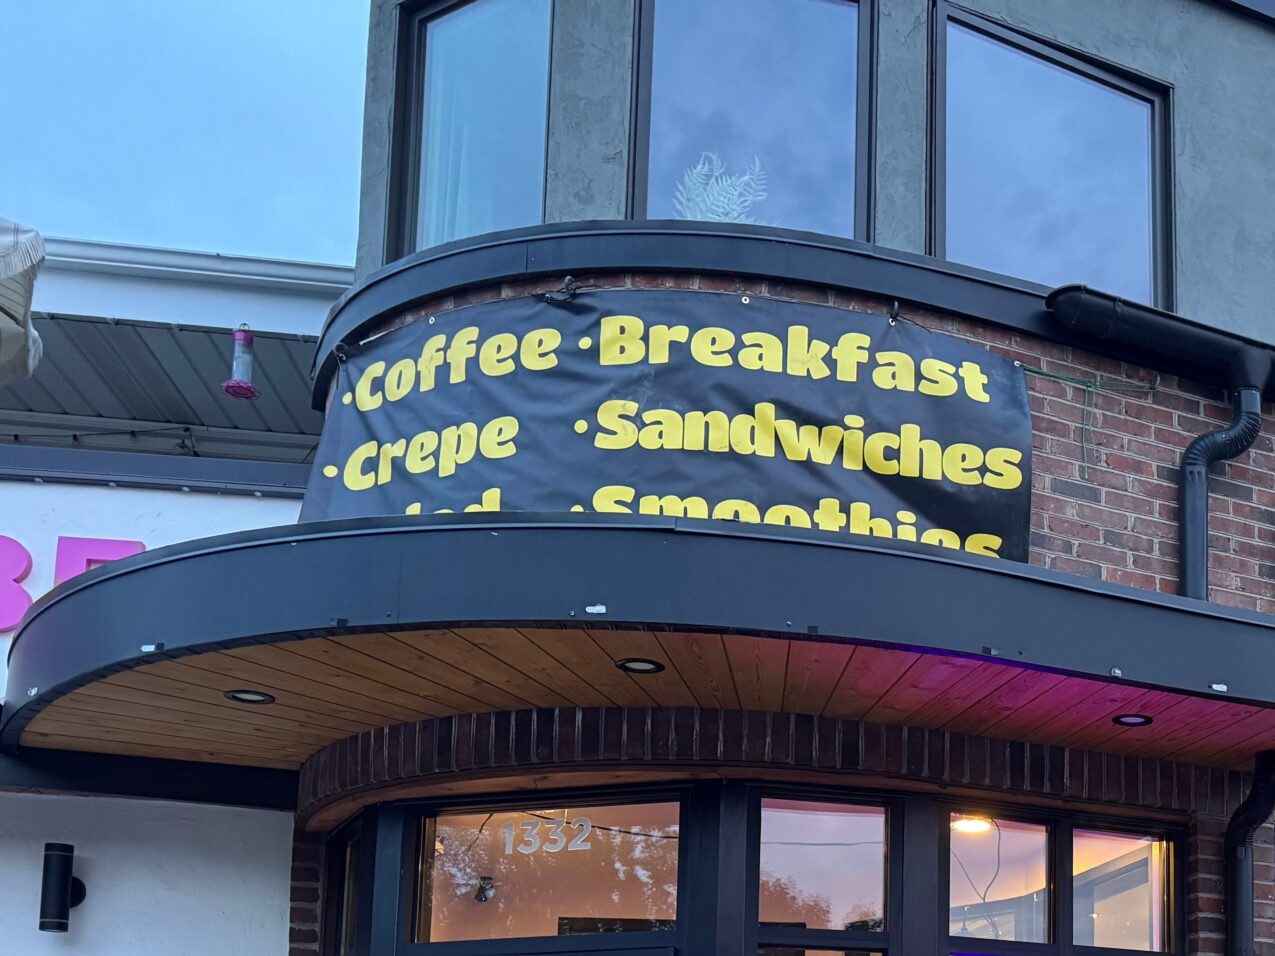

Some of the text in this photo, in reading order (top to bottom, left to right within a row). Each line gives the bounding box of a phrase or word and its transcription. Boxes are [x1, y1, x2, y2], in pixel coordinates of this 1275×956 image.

[355, 325, 561, 412] Coffee
[599, 315, 991, 403] Breakfast
[343, 415, 520, 491] Crepe
[593, 400, 1023, 490] Sandwiches
[502, 816, 592, 855] 1332
